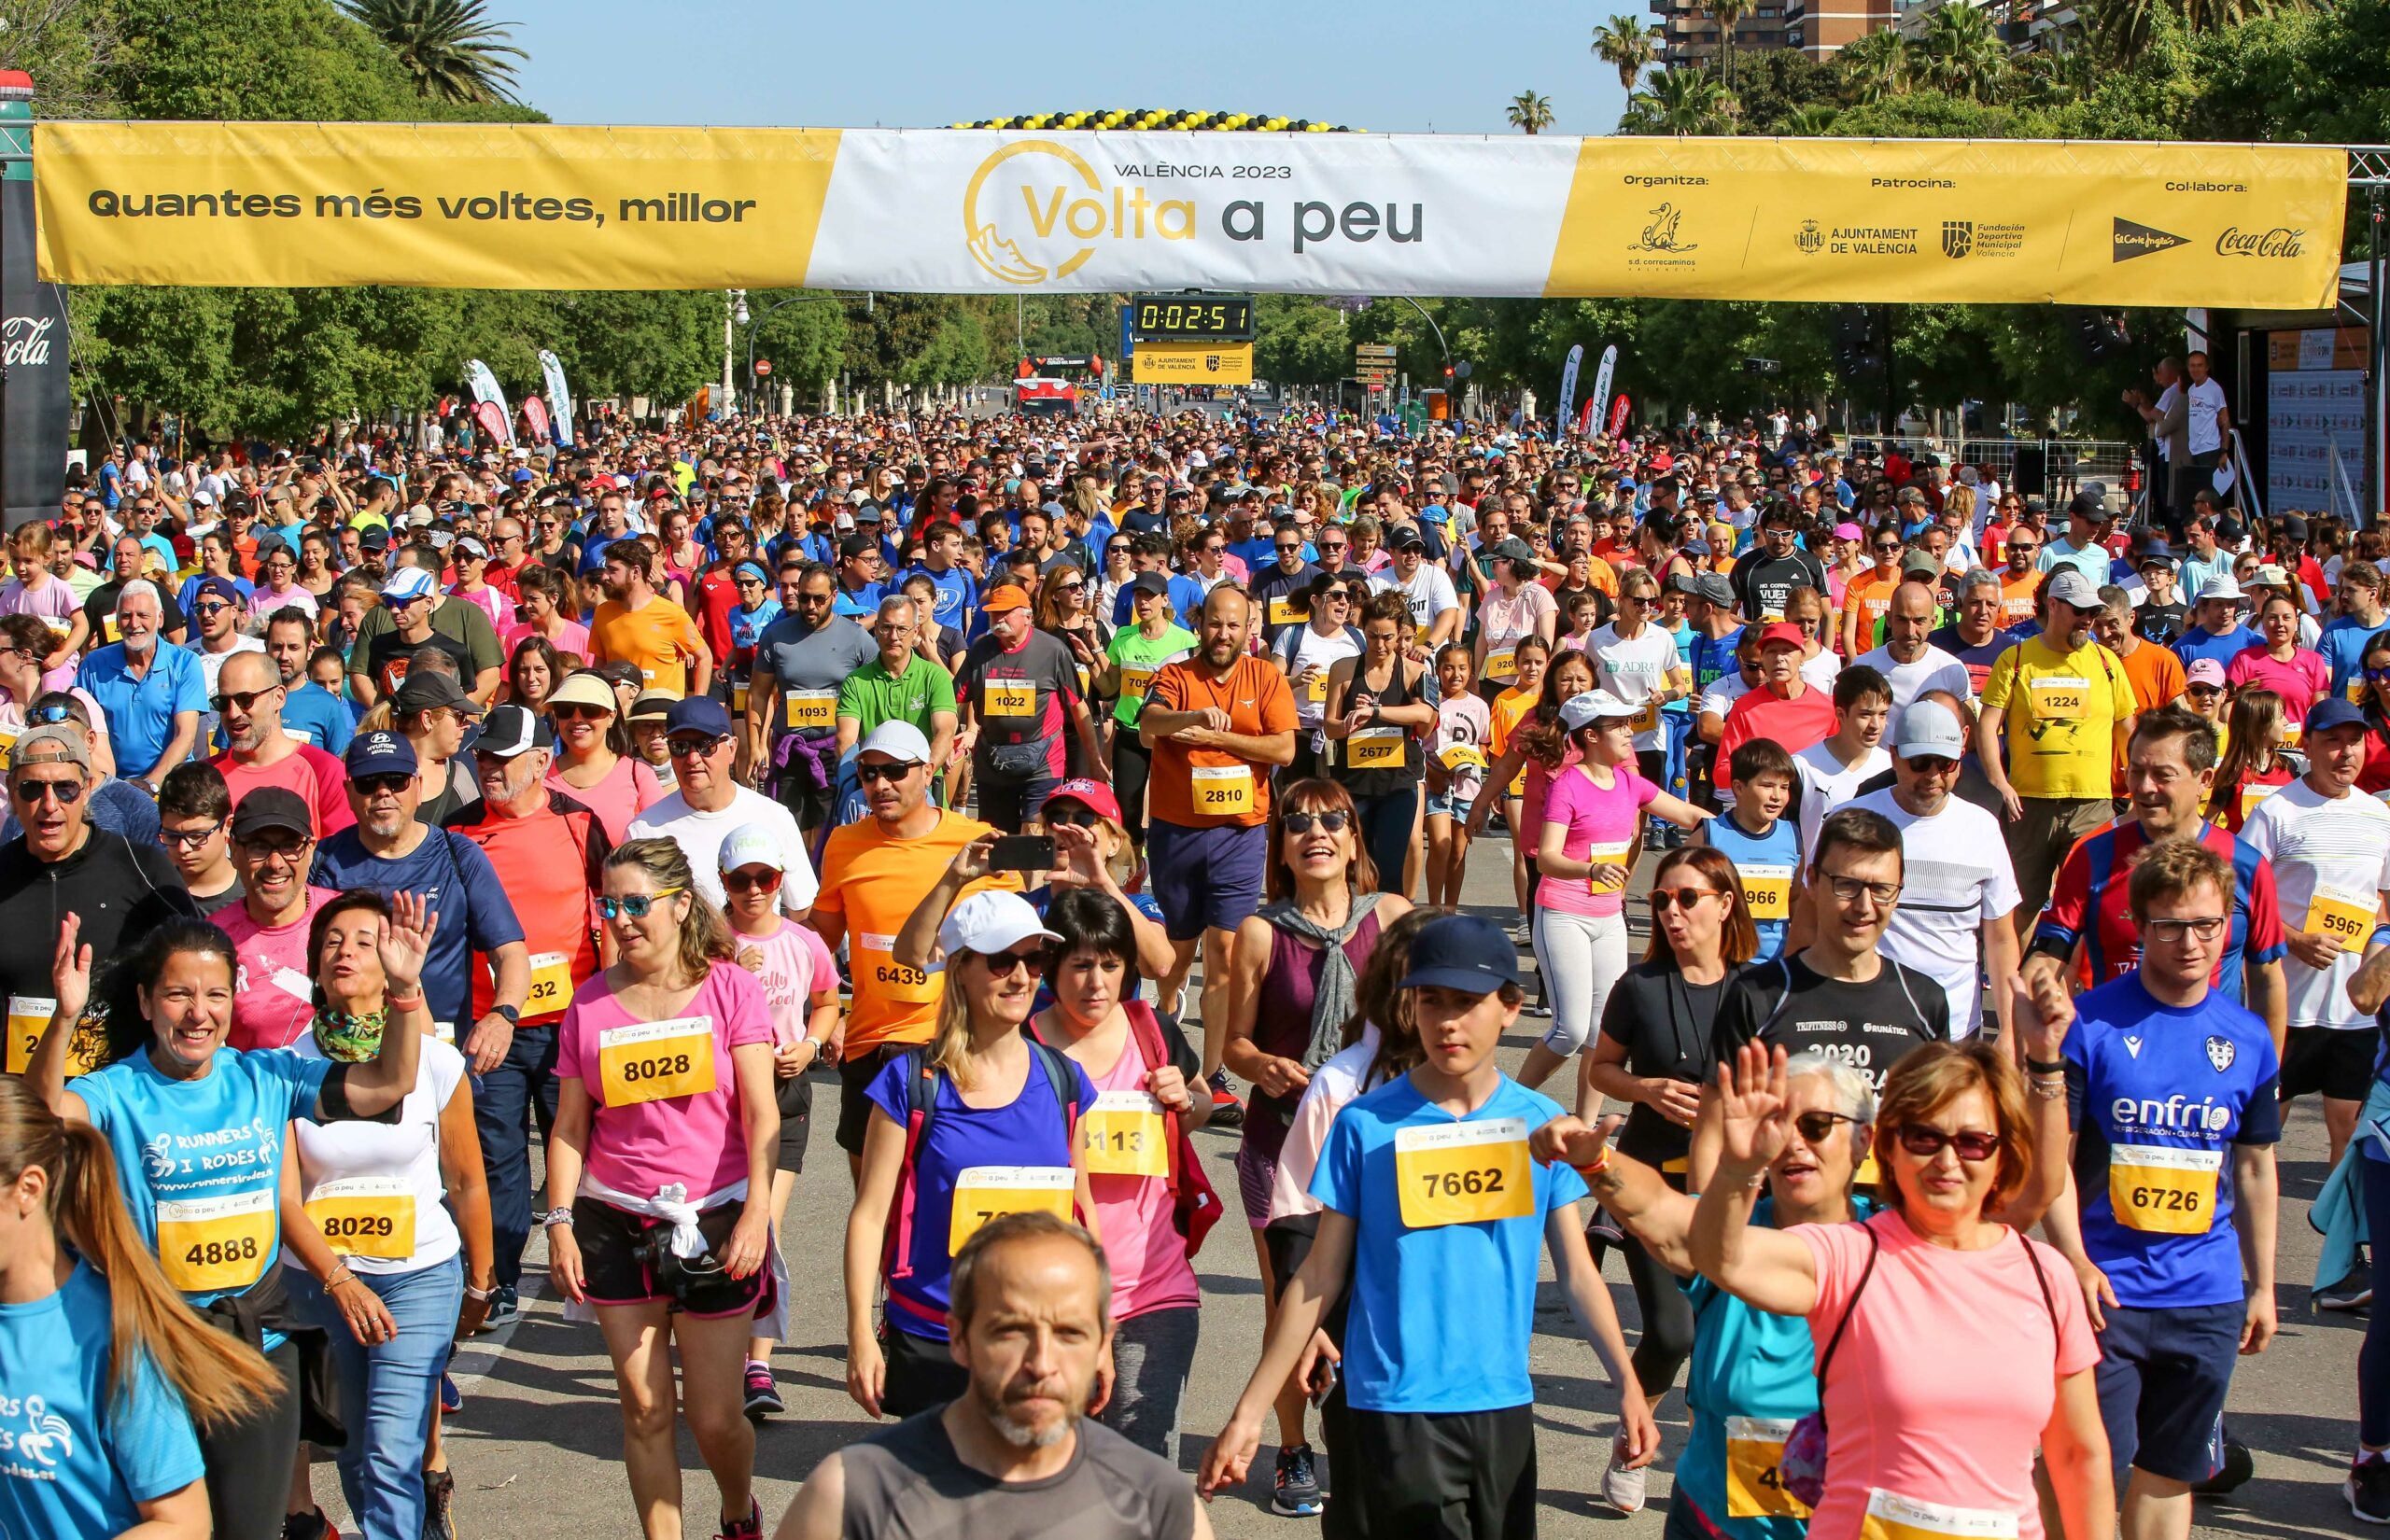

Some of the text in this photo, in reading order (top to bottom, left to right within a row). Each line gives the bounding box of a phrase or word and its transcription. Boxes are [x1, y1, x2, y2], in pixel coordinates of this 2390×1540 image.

[1114, 161, 1291, 179] VALÈNCIA 2023
[1624, 175, 1709, 188] Organitza:
[1871, 178, 1956, 189] Patrocina:
[88, 187, 757, 229] Quantes més voltes, millor
[1020, 186, 1423, 254] Volta a peu
[1977, 223, 2025, 232] Fundación
[1832, 229, 1918, 240] AJUNTAMENT
[1976, 232, 2023, 242] Deportiva
[2115, 231, 2176, 248] El Corte Inglés
[1831, 239, 1918, 255] DE VALÈNCIA
[1976, 241, 2022, 250] Municipal
[1643, 258, 1696, 266] correcaminos
[1141, 305, 1246, 329] 0:02:51
[2, 316, 56, 366] ola
[1759, 590, 1788, 600] VUEL
[1623, 662, 1654, 673] ADRA
[995, 696, 1025, 707] 1022
[2045, 696, 2079, 707] 1224
[798, 707, 828, 718] 1093
[1358, 747, 1393, 758] 2677
[1205, 789, 1243, 803] 2810
[2323, 913, 2363, 937] 5967
[876, 966, 928, 986] 6439
[527, 980, 557, 1000] 32
[1796, 1020, 1836, 1031] TRIFITNESS
[1872, 1024, 1908, 1036] RUNÁTICA
[1808, 1043, 1871, 1066] 2020
[624, 1055, 690, 1082] 8028
[2112, 1094, 2230, 1131] enfrío
[176, 1126, 253, 1149] RUNNERS
[180, 1150, 257, 1173] I RODES
[1422, 1168, 1505, 1198] 7662
[2132, 1186, 2199, 1211] 6726
[202, 1206, 216, 1214] peu
[324, 1216, 393, 1237] 8029
[186, 1237, 258, 1266] 4888
[1920, 1512, 1940, 1522] peu
